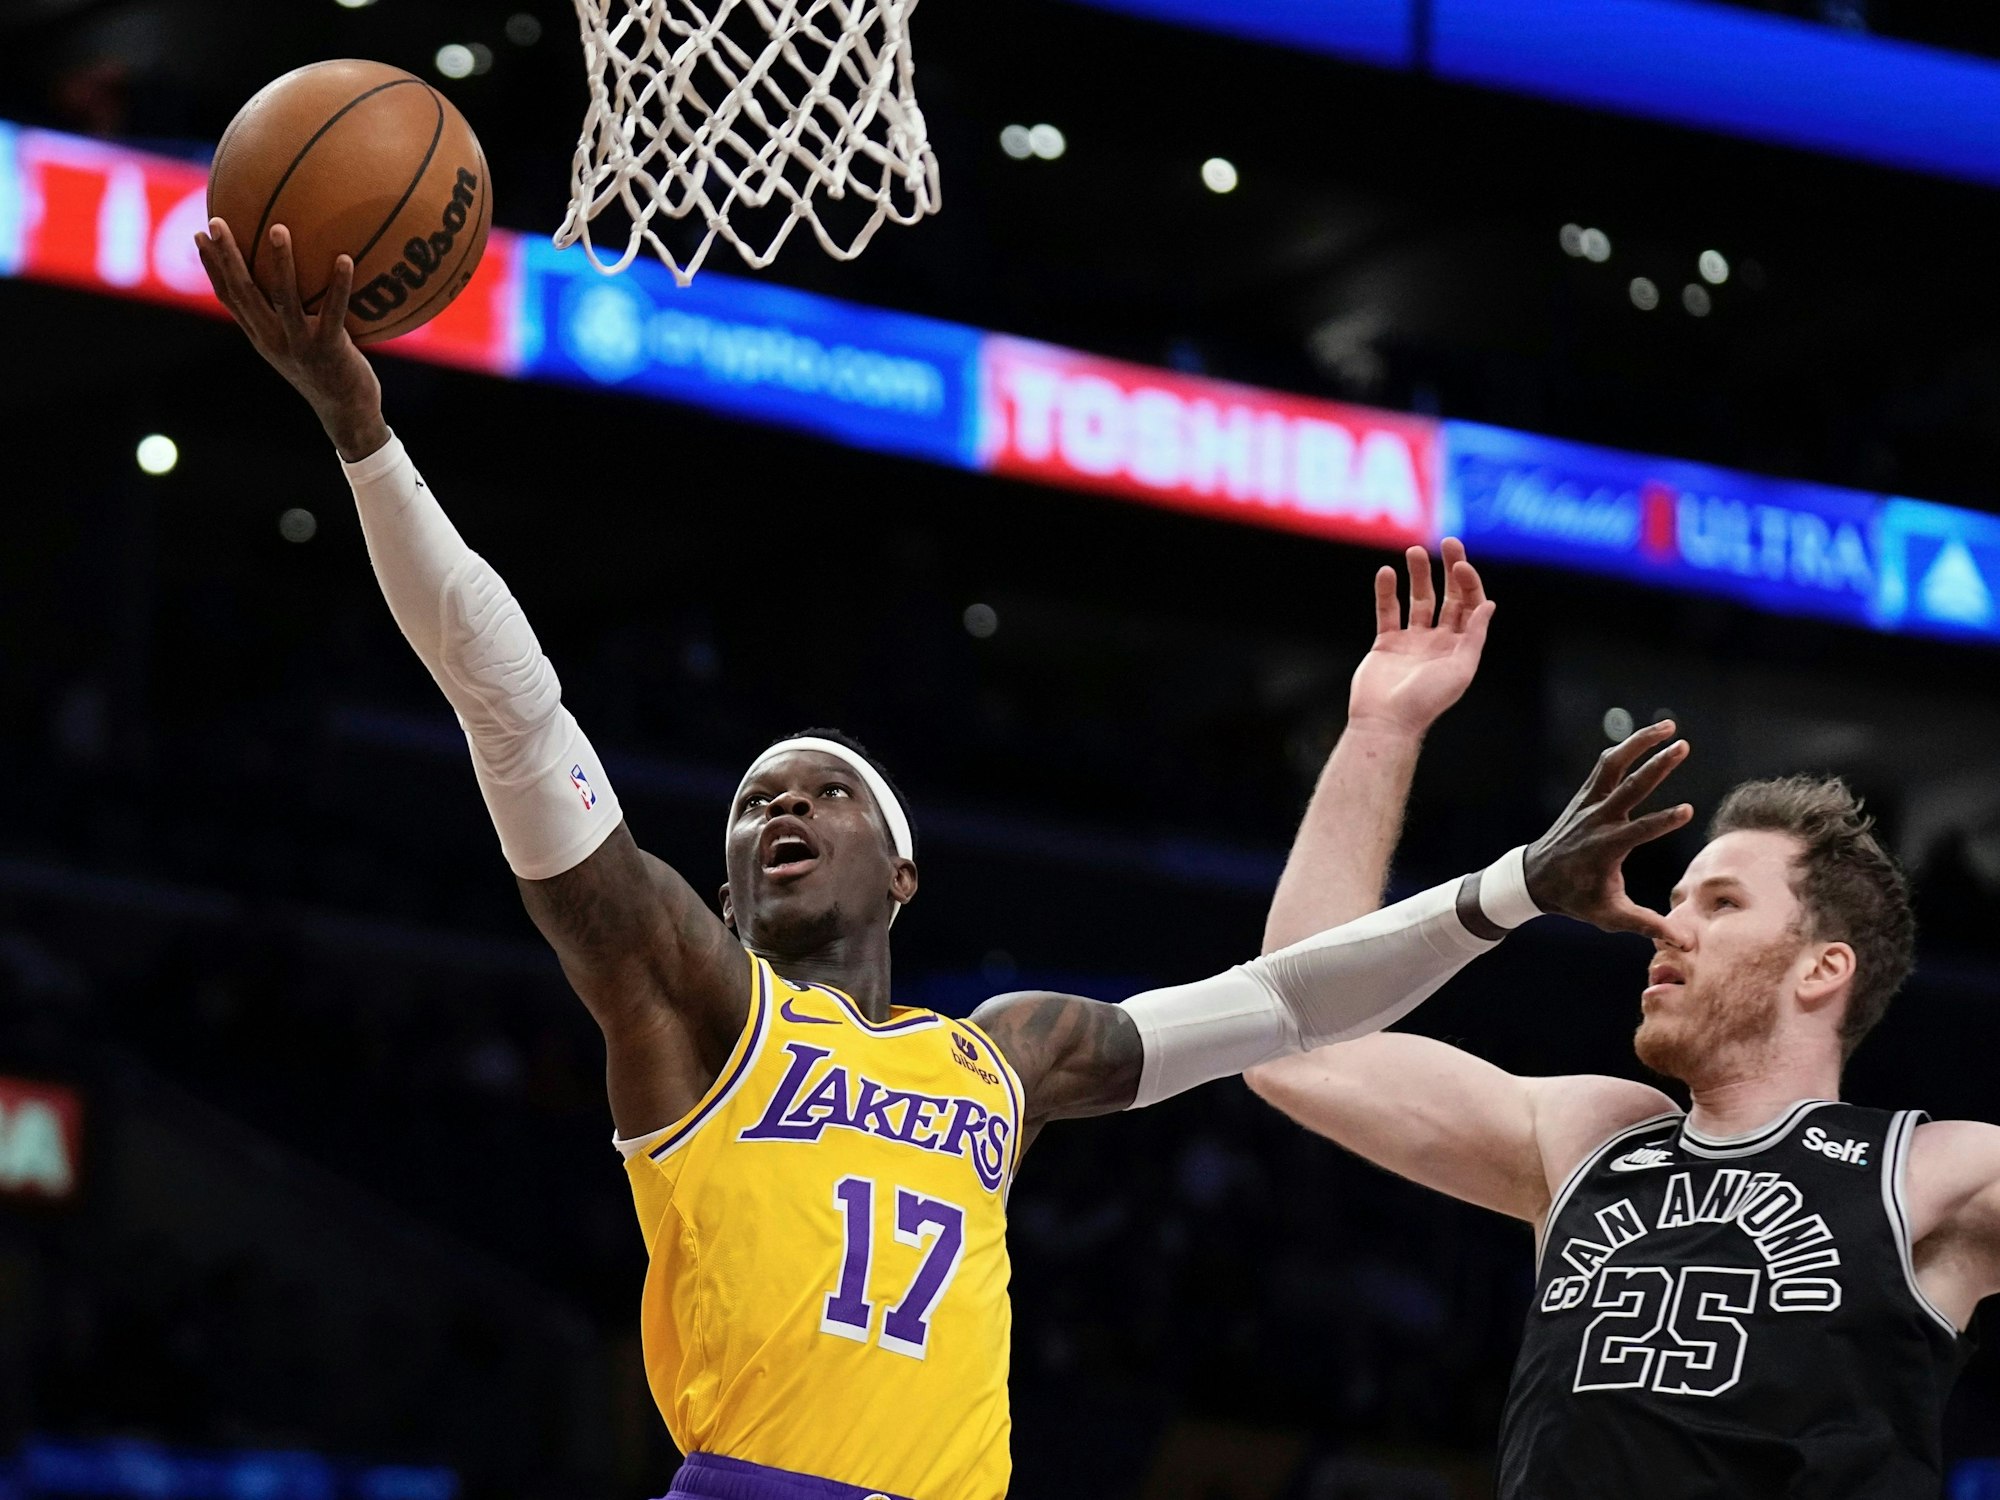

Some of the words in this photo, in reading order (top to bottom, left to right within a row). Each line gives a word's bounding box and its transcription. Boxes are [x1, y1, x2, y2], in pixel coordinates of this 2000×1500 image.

[348, 166, 478, 322] Wilson
[1006, 364, 1424, 531] TOSHIBA
[1675, 490, 1874, 595] ULTRA
[736, 1040, 1009, 1195] LAKERS
[950, 1048, 1000, 1087] bibigo
[818, 1173, 968, 1361] 17
[1541, 1198, 1648, 1312] SAN
[1656, 1168, 1842, 1312] ANTONIO
[1572, 1265, 1761, 1397] 25
